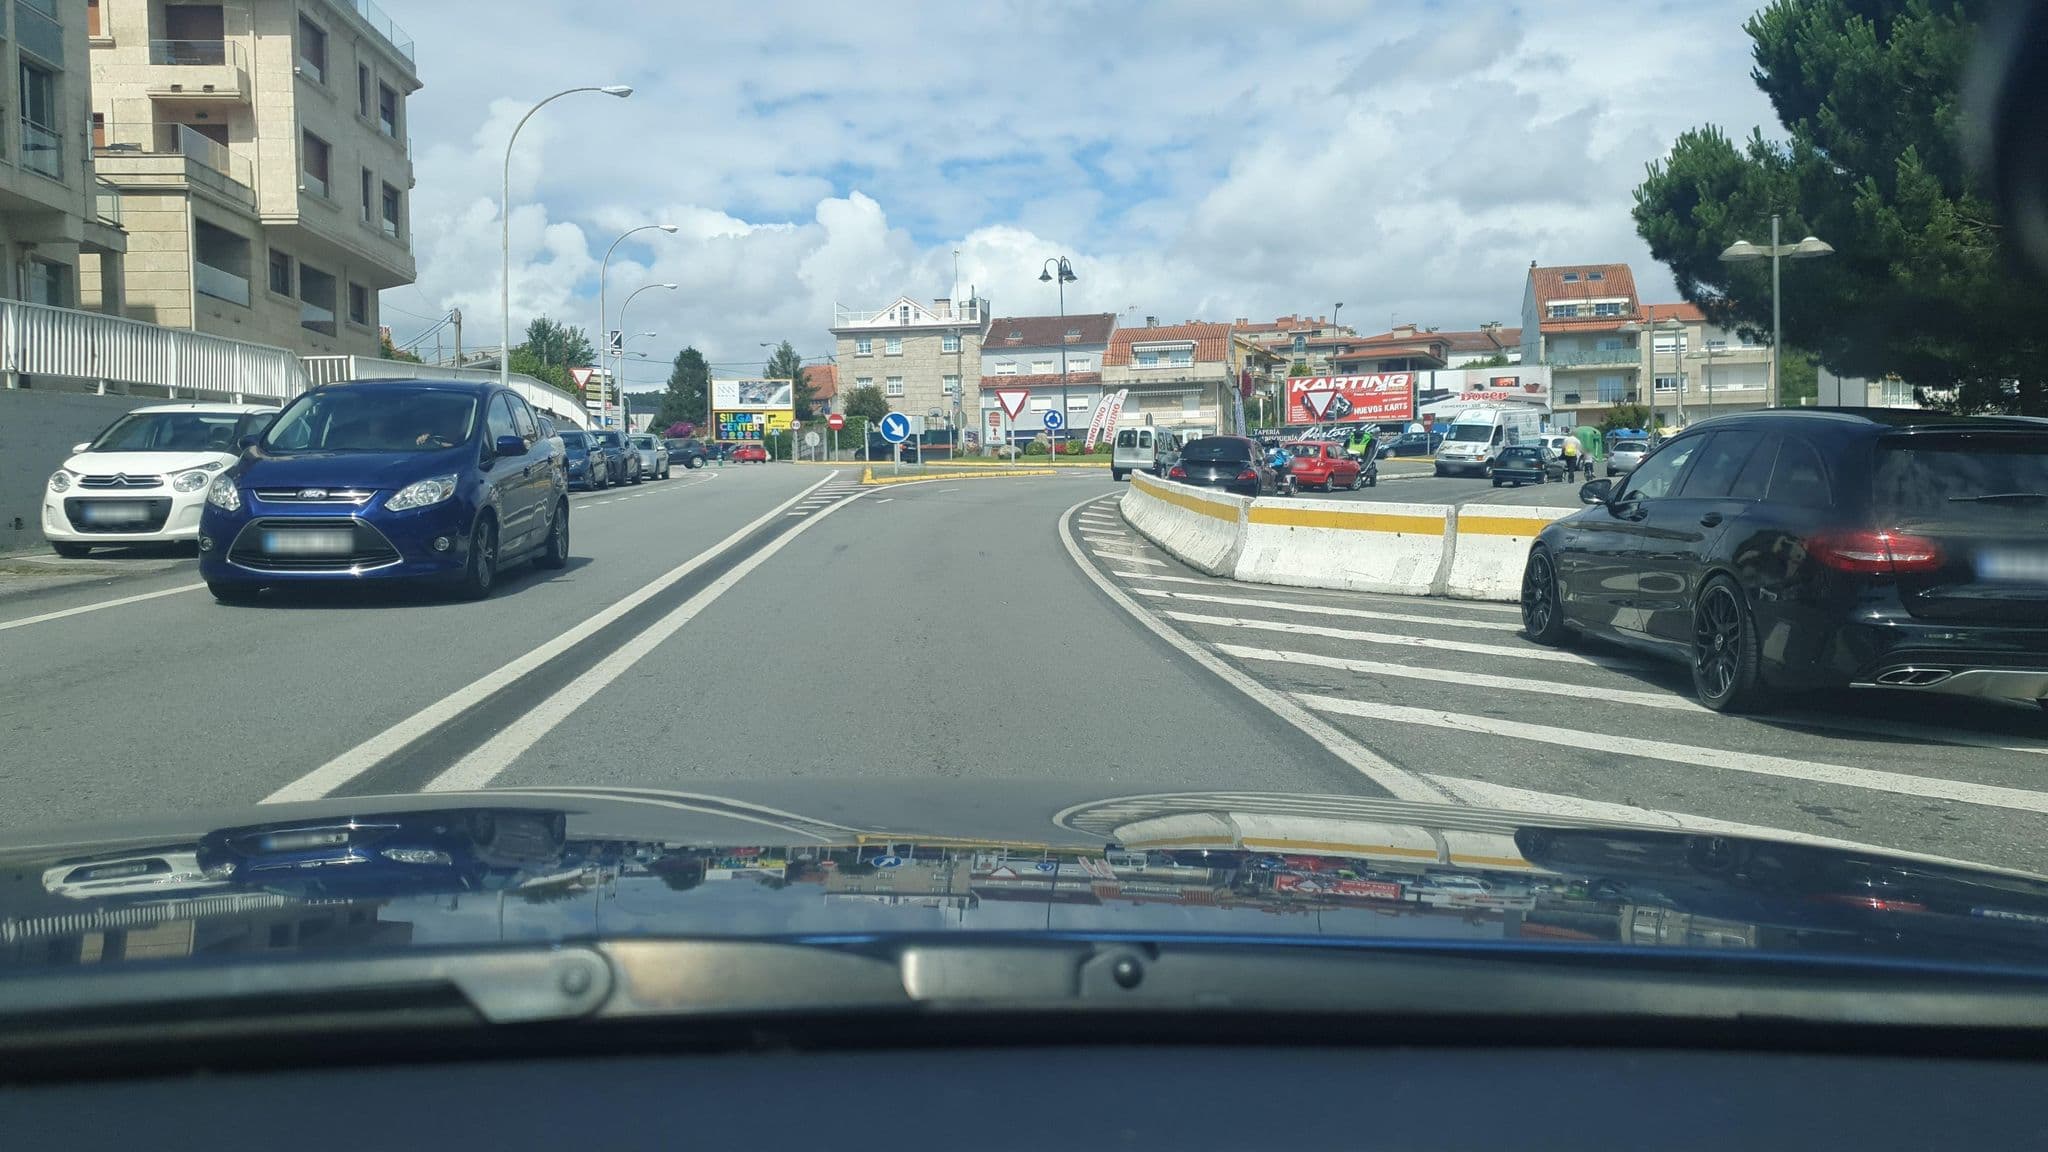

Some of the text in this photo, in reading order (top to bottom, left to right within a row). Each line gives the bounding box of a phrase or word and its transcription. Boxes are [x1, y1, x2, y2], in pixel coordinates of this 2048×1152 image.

[1292, 374, 1409, 392] KARTING
[1354, 402, 1408, 415] NUEVOS KARTS
[720, 413, 753, 423] SILGA
[720, 423, 760, 432] CENTER
